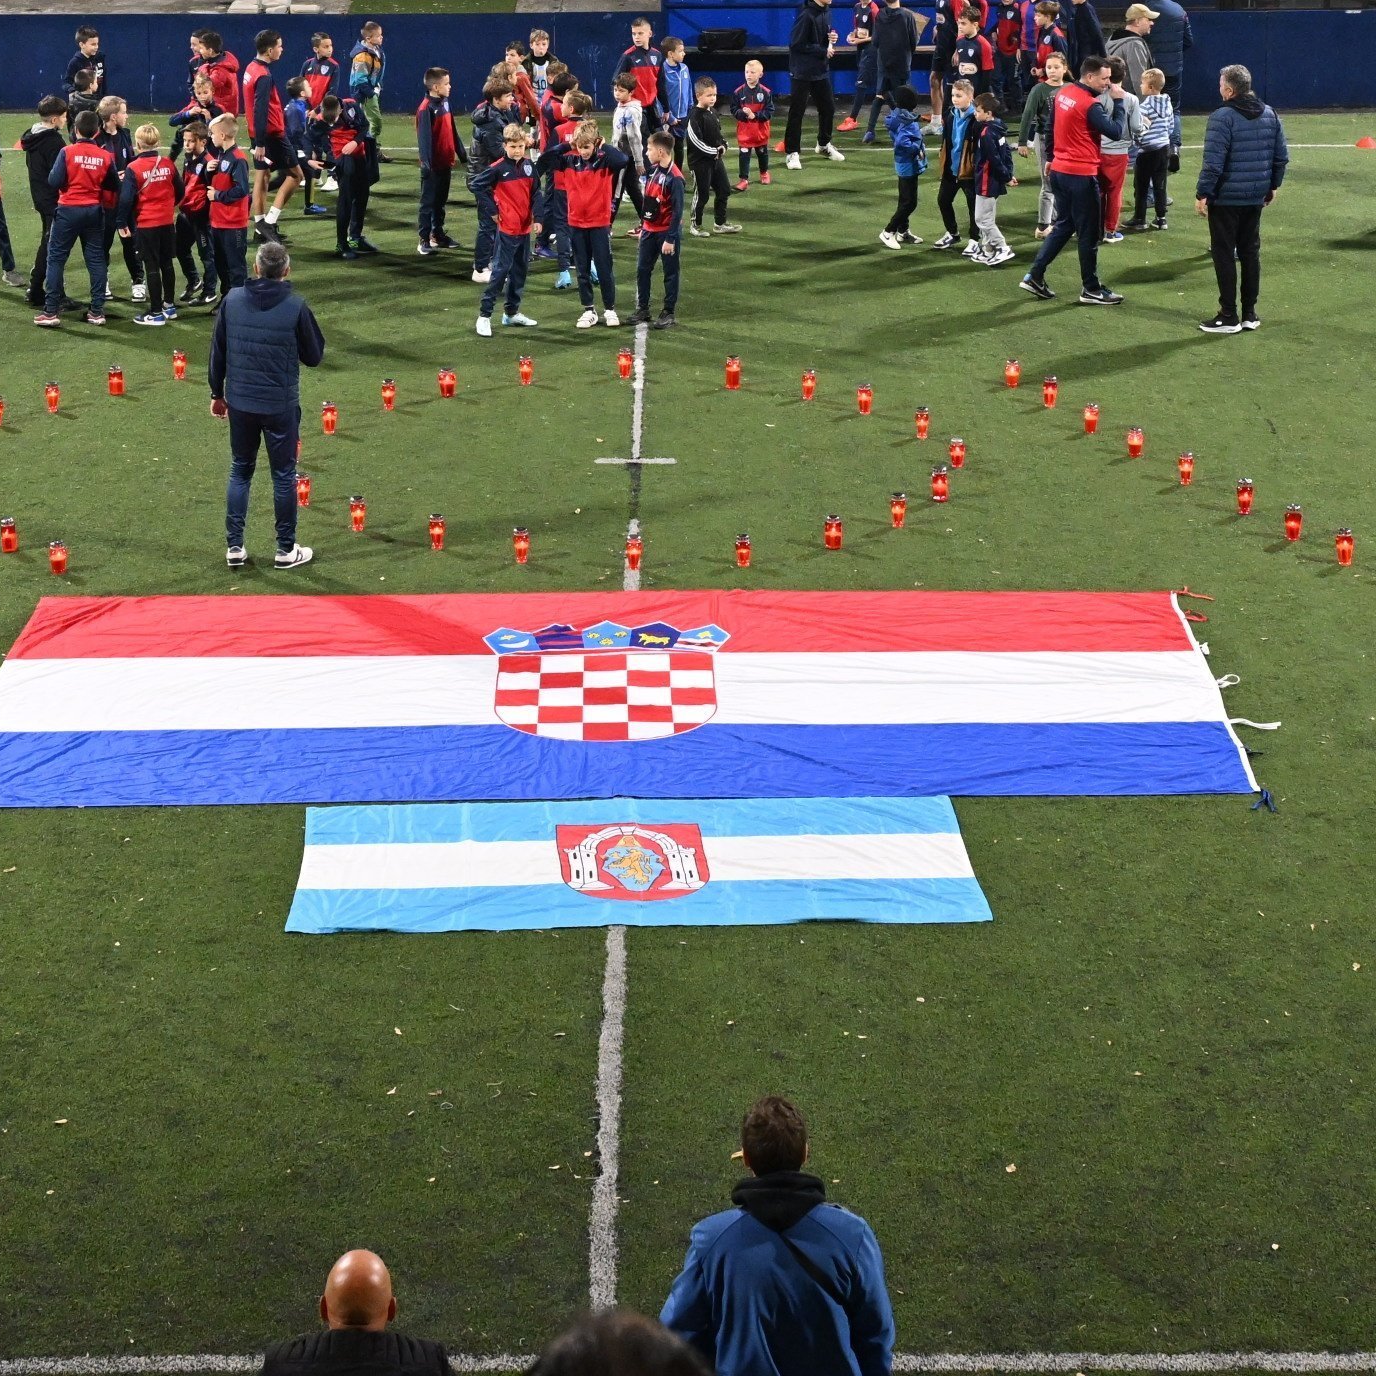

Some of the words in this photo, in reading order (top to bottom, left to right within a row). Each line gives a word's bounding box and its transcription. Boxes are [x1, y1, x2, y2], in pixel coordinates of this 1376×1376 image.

[536, 79, 547, 90] 10
[74, 155, 84, 164] NK
[84, 156, 104, 166] ZAMET
